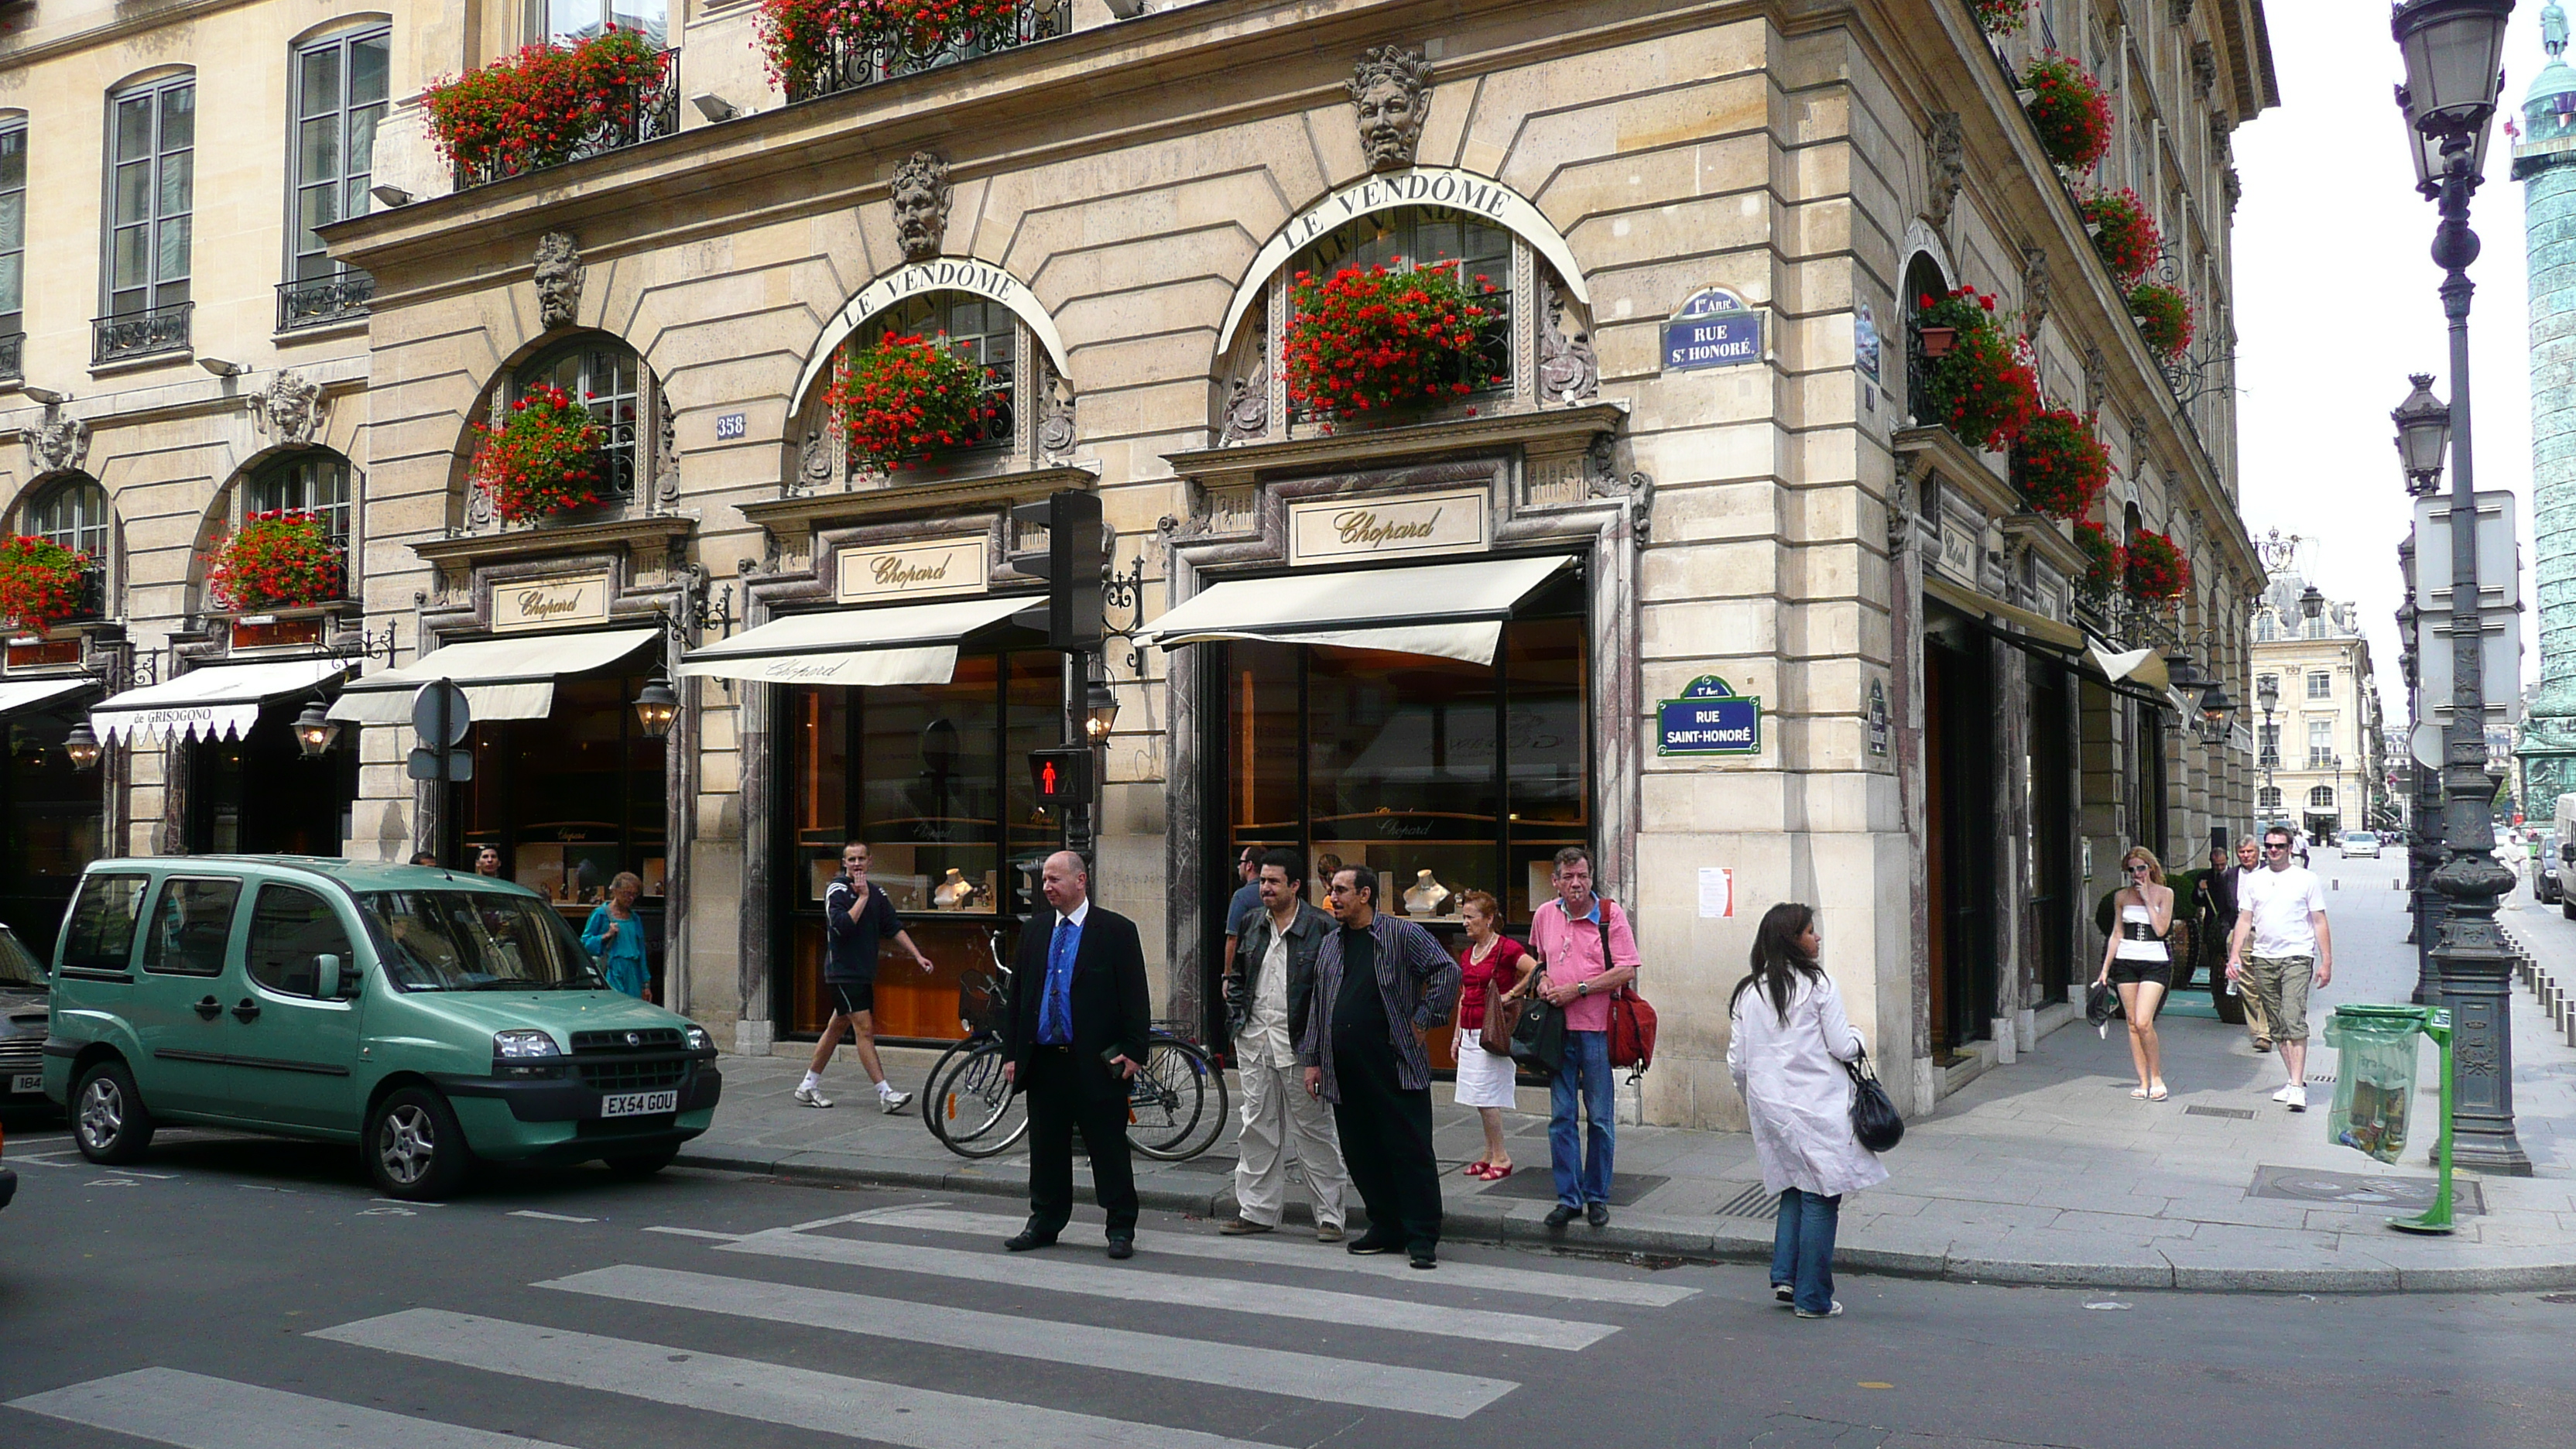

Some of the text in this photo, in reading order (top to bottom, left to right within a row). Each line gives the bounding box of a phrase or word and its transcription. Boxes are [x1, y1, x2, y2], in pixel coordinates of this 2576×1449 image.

[1282, 211, 1324, 251] LE
[1337, 172, 1512, 218] VENDÔME
[843, 261, 1017, 329] LE VENDÔME
[1694, 325, 1728, 342] RUE
[718, 416, 743, 436] 358
[1334, 507, 1442, 549] Chopard
[870, 553, 952, 589] Chopard
[518, 587, 583, 619] Chopard
[765, 658, 851, 680] Chopard
[134, 708, 211, 724] de GRISOGONO
[1696, 711, 1720, 723] RUE
[1667, 726, 1751, 743] SAINT-HONORÉ
[1376, 819, 1434, 838] Chopard
[20, 1077, 41, 1088] 184
[608, 1093, 673, 1114] EX54 GOU
